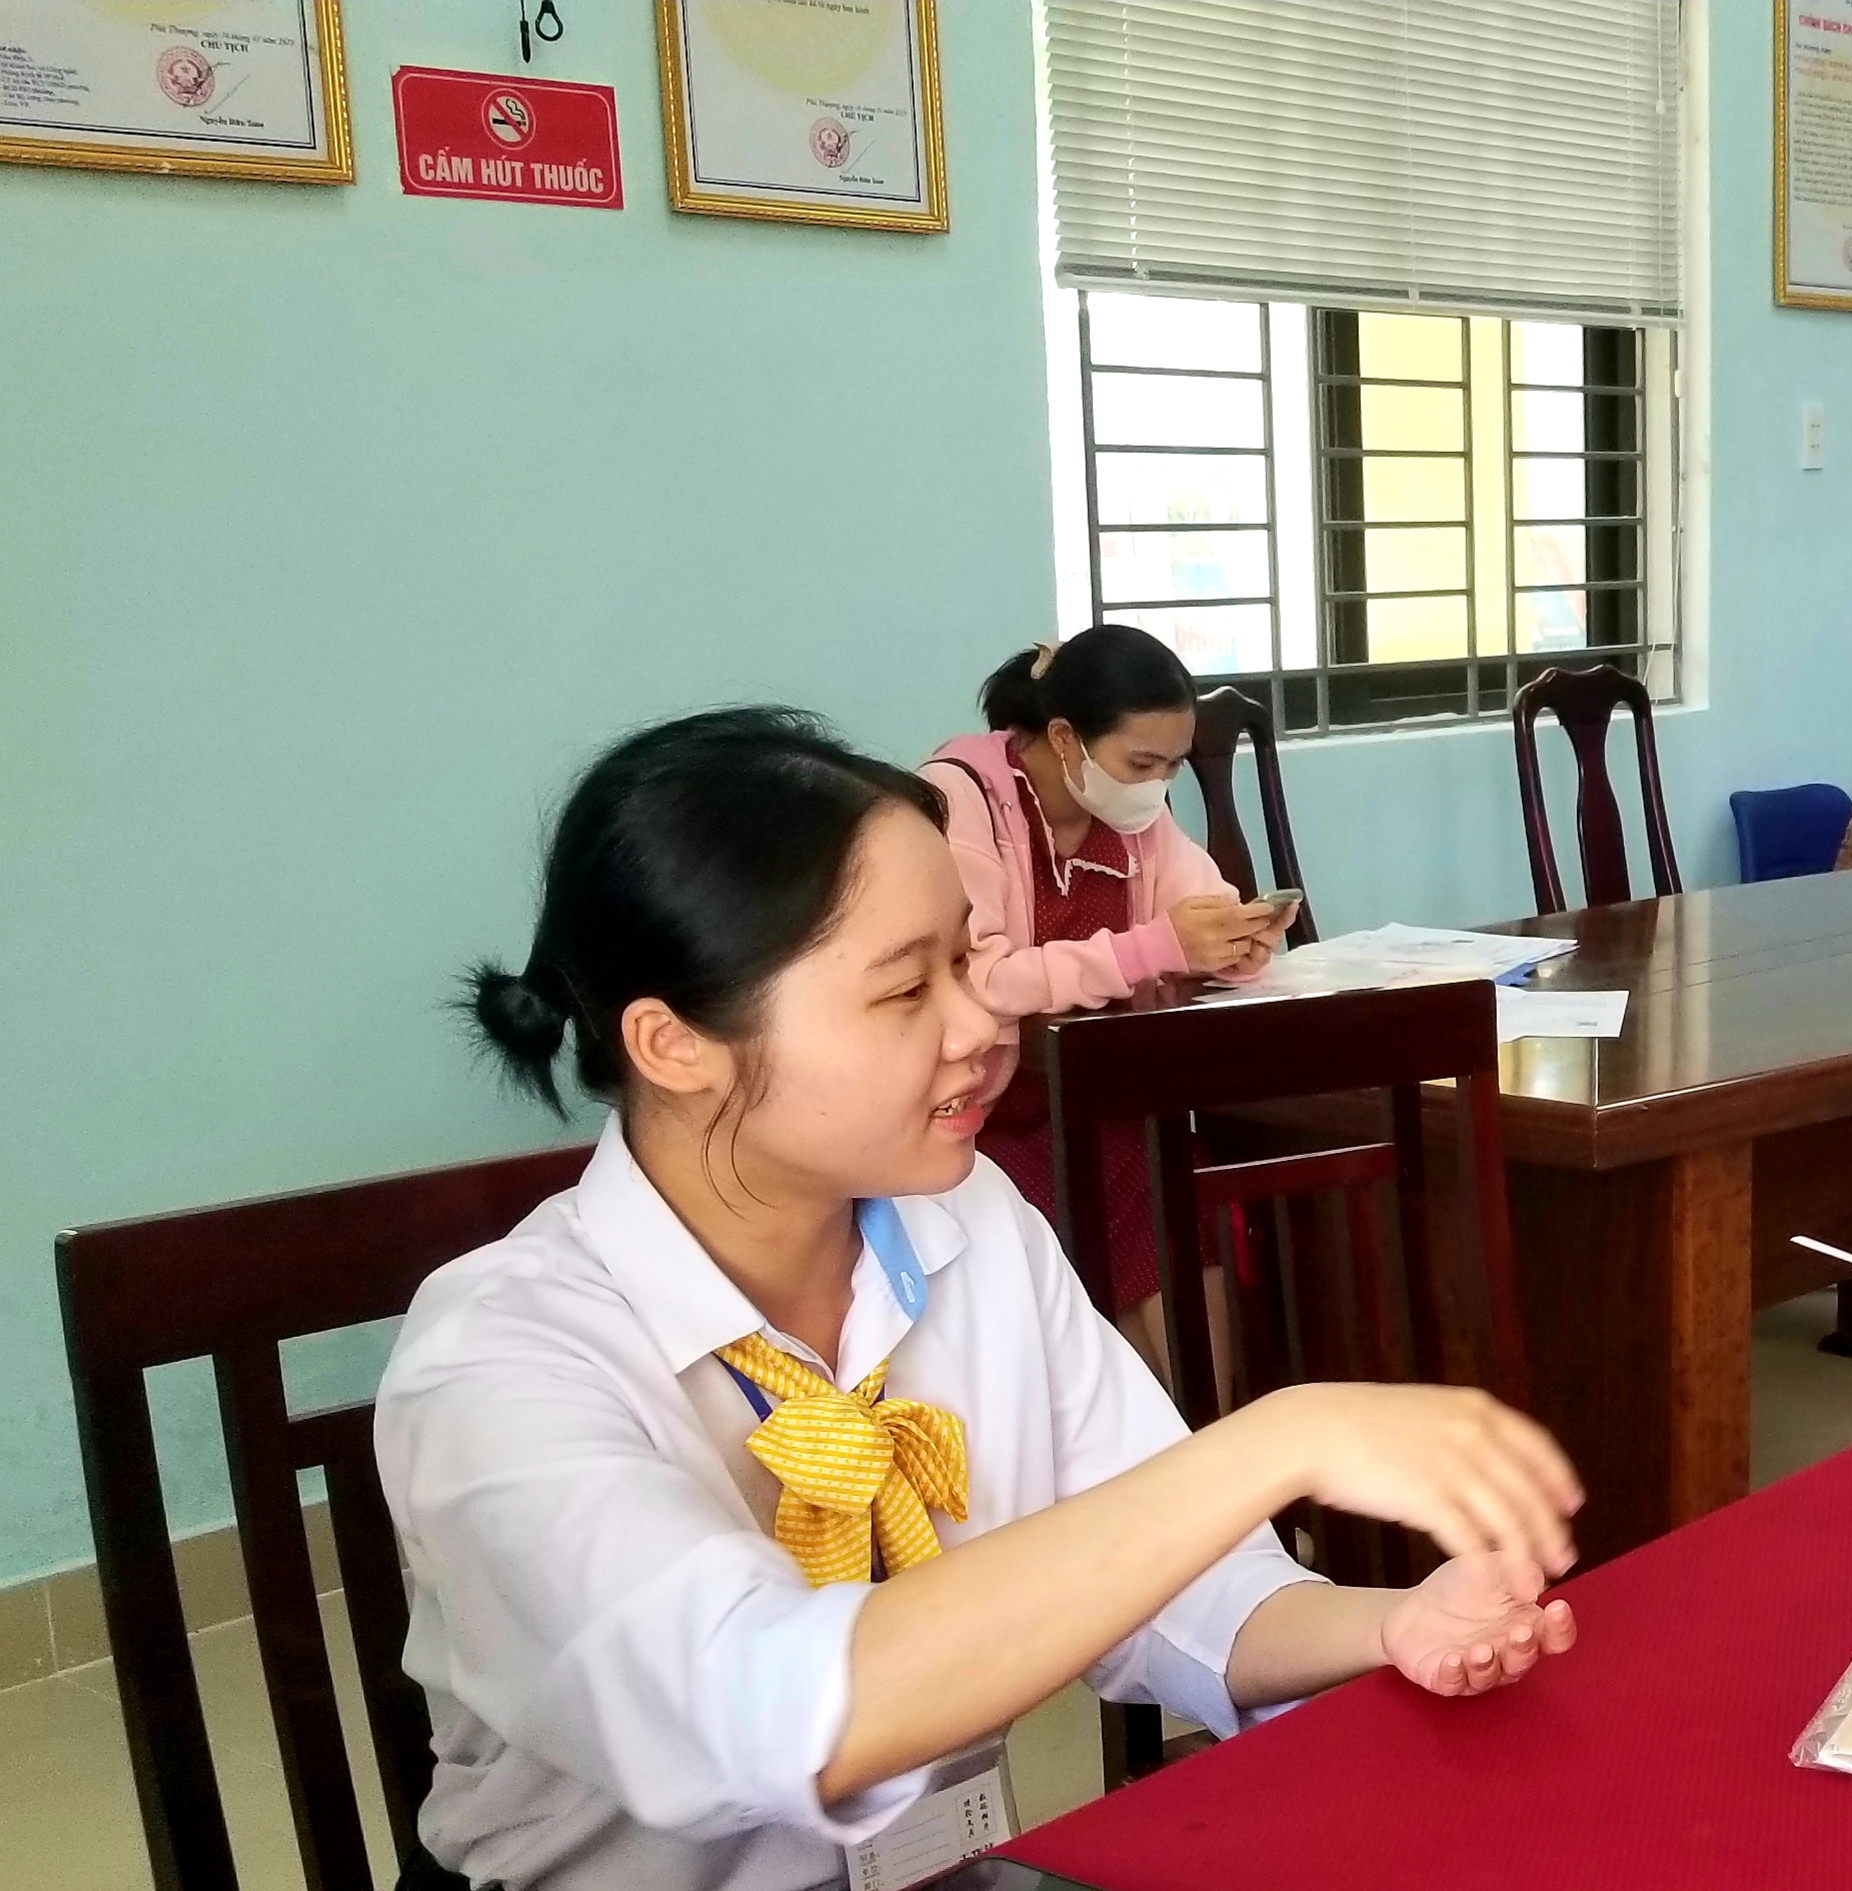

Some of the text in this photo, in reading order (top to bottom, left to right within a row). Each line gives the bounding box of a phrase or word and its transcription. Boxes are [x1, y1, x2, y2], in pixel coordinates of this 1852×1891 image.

[419, 146, 604, 193] CẤM HÚT THUỐC
